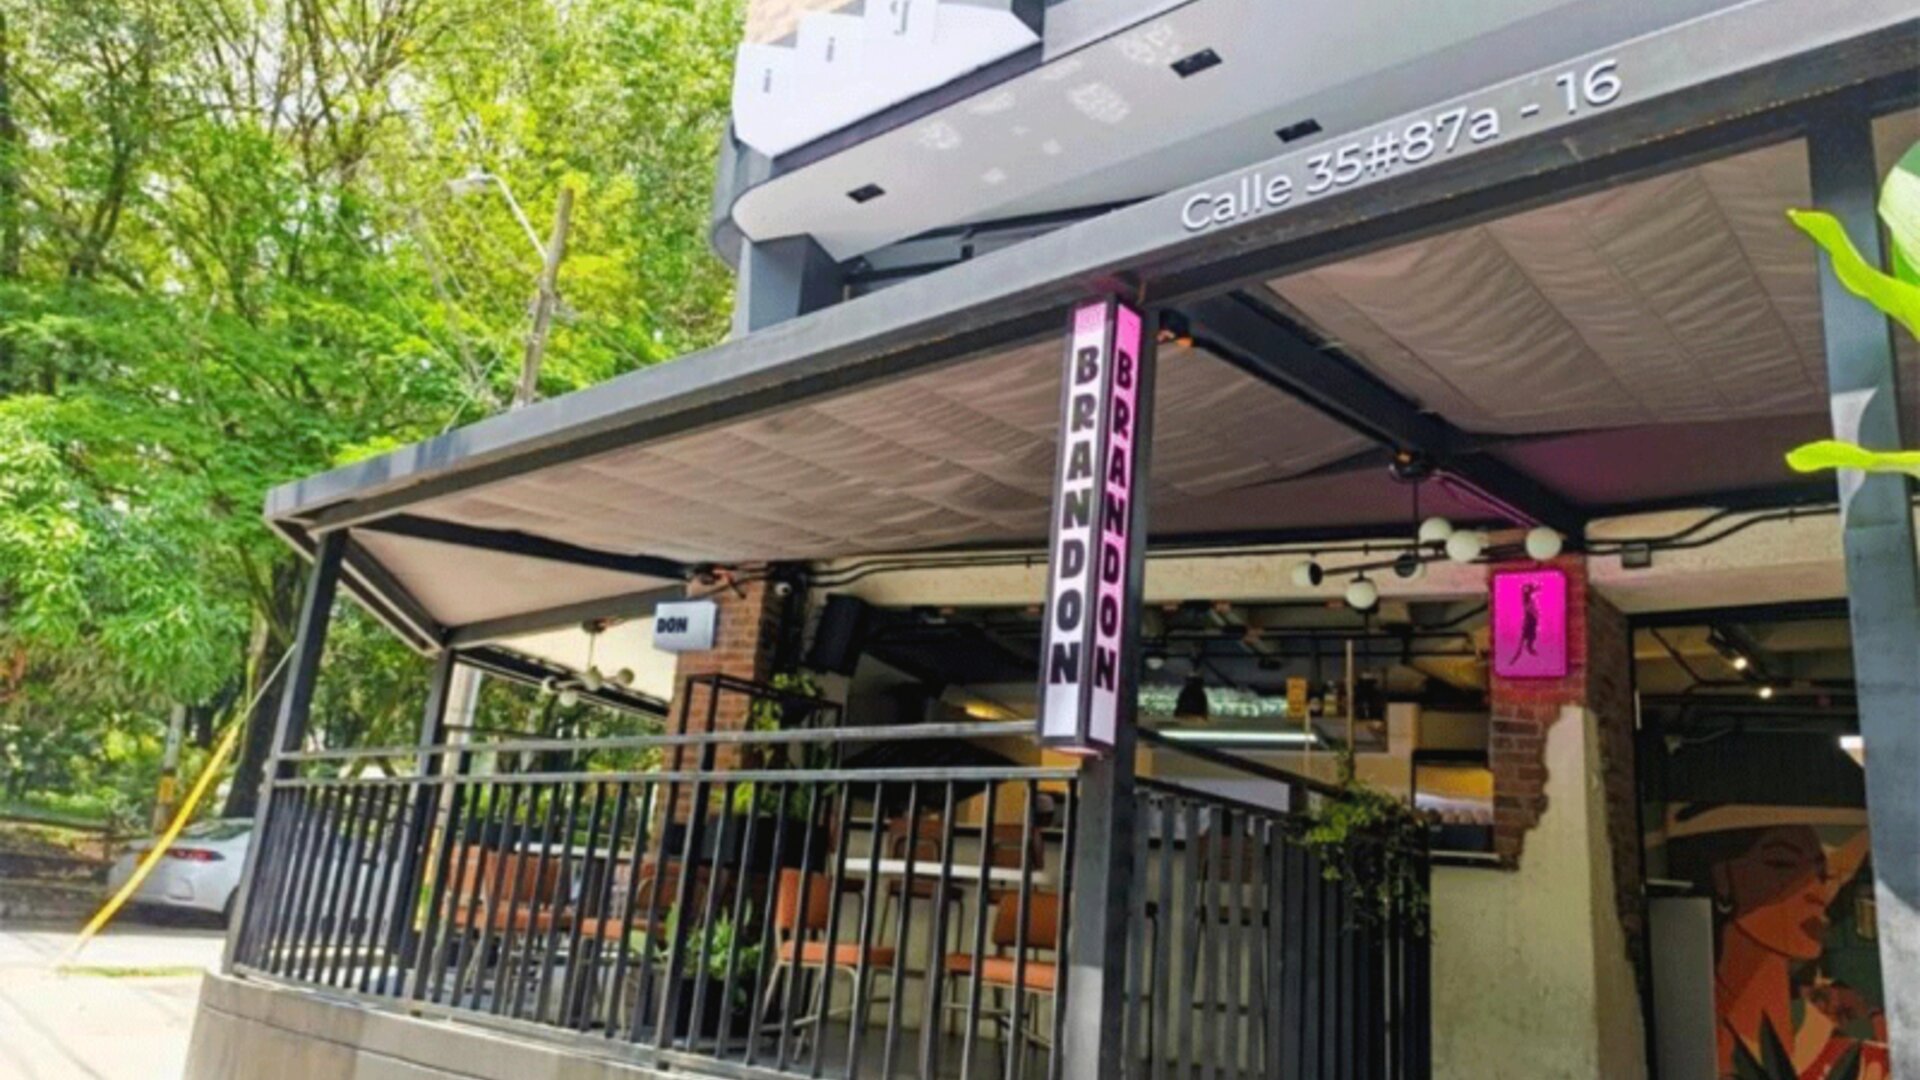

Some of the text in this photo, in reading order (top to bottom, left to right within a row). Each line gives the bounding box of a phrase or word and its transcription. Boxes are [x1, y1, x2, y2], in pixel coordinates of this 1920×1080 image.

[1181, 173, 1292, 232] Calle
[1305, 105, 1500, 194] 35#87a
[1556, 58, 1623, 114] 16
[656, 616, 688, 634] DON
[1049, 346, 1099, 685] BRANDON
[1095, 349, 1132, 693] BRANDON
